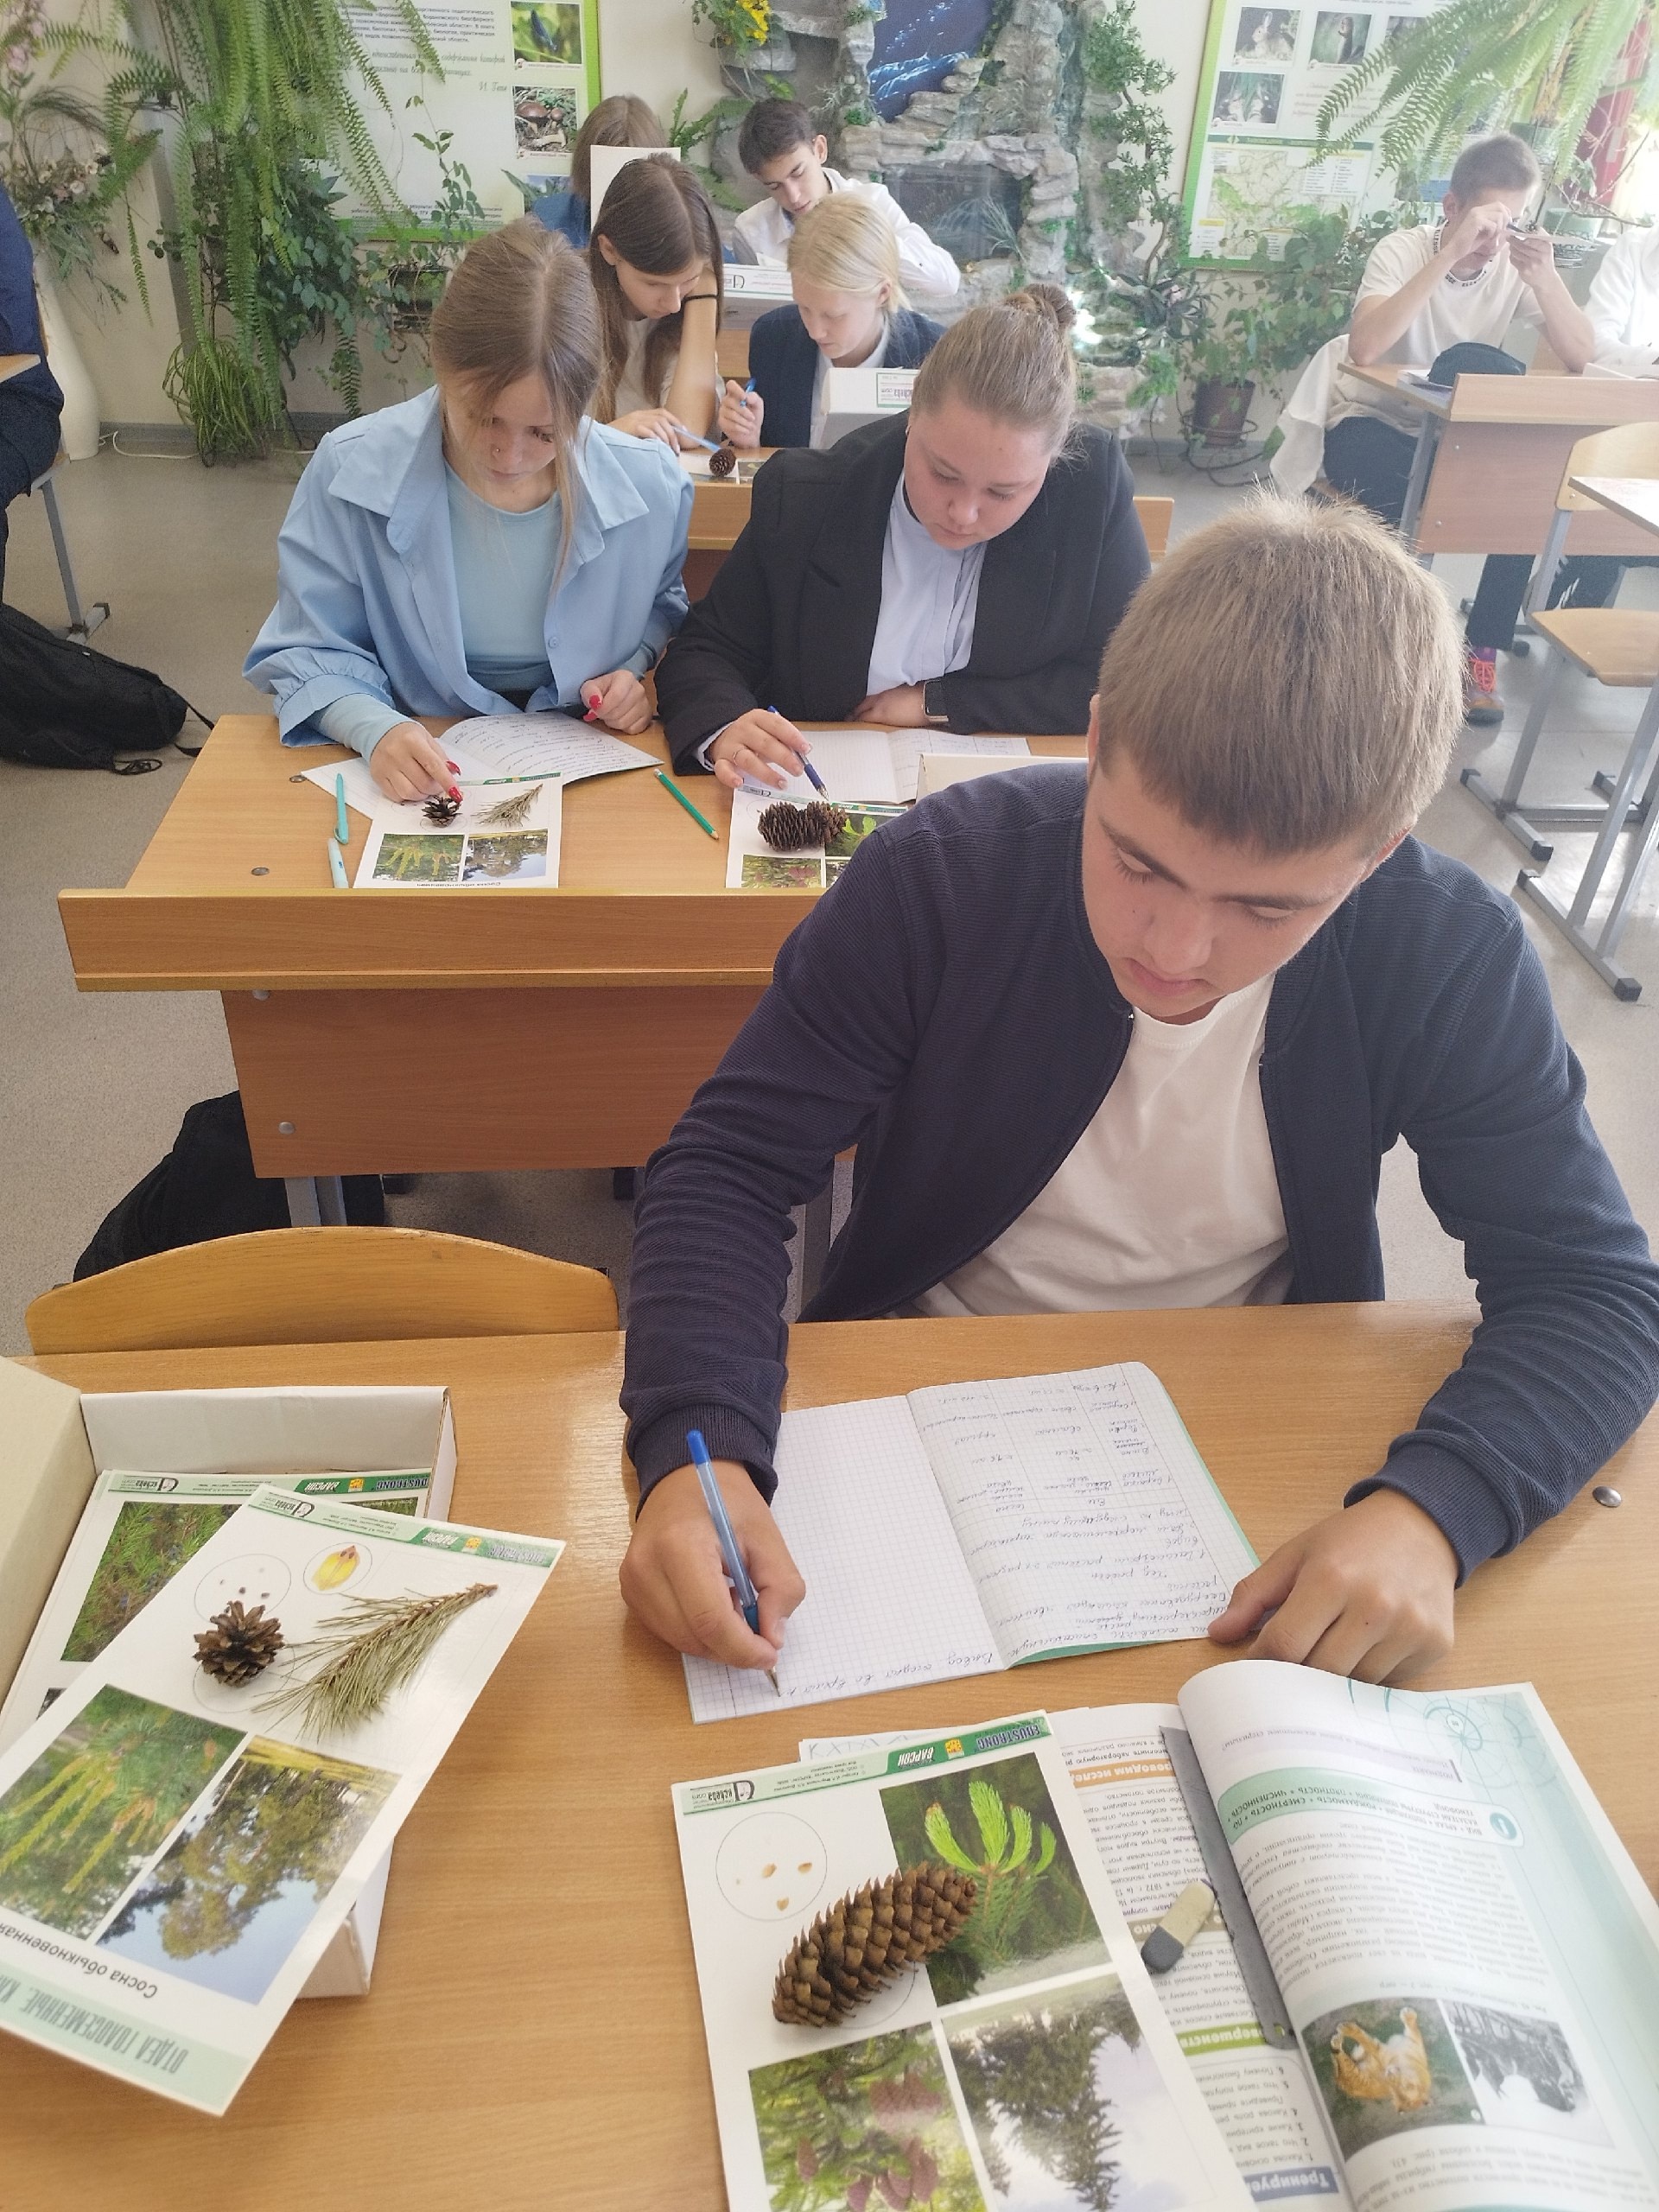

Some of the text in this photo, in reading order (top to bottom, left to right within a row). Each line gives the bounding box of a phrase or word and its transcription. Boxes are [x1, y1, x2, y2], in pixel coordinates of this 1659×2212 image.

[375, 1478, 429, 1490] DUSTRONG
[976, 1724, 1040, 1751] EDUSTRONG
[897, 1746, 934, 1766] ВАРСОН
[1115, 1762, 1172, 1776] роводим
[1230, 1789, 1287, 1817] ЧИСЛЕННОСТЬ
[1249, 1796, 1306, 1816] СМЕРТНОСТЬ
[0, 1923, 158, 1999] Сосна обыкновенная
[1152, 1978, 1171, 1986] текс
[1178, 2026, 1262, 2048] вершенст
[135, 2036, 188, 2074] ОТДЕЛ
[1236, 2082, 1260, 2093] такое
[1240, 2094, 1283, 2108] Приведите
[1214, 2113, 1230, 2125] реп
[1233, 2108, 1254, 2121] роль
[1258, 2108, 1287, 2119] Какова
[1268, 2122, 1293, 2133] Какие
[1236, 2141, 1252, 2152] вид
[1255, 2139, 1279, 2150] такое
[1281, 2138, 1298, 2147] Что
[1236, 2157, 1269, 2168] основна
[1273, 2154, 1303, 2164] Какова
